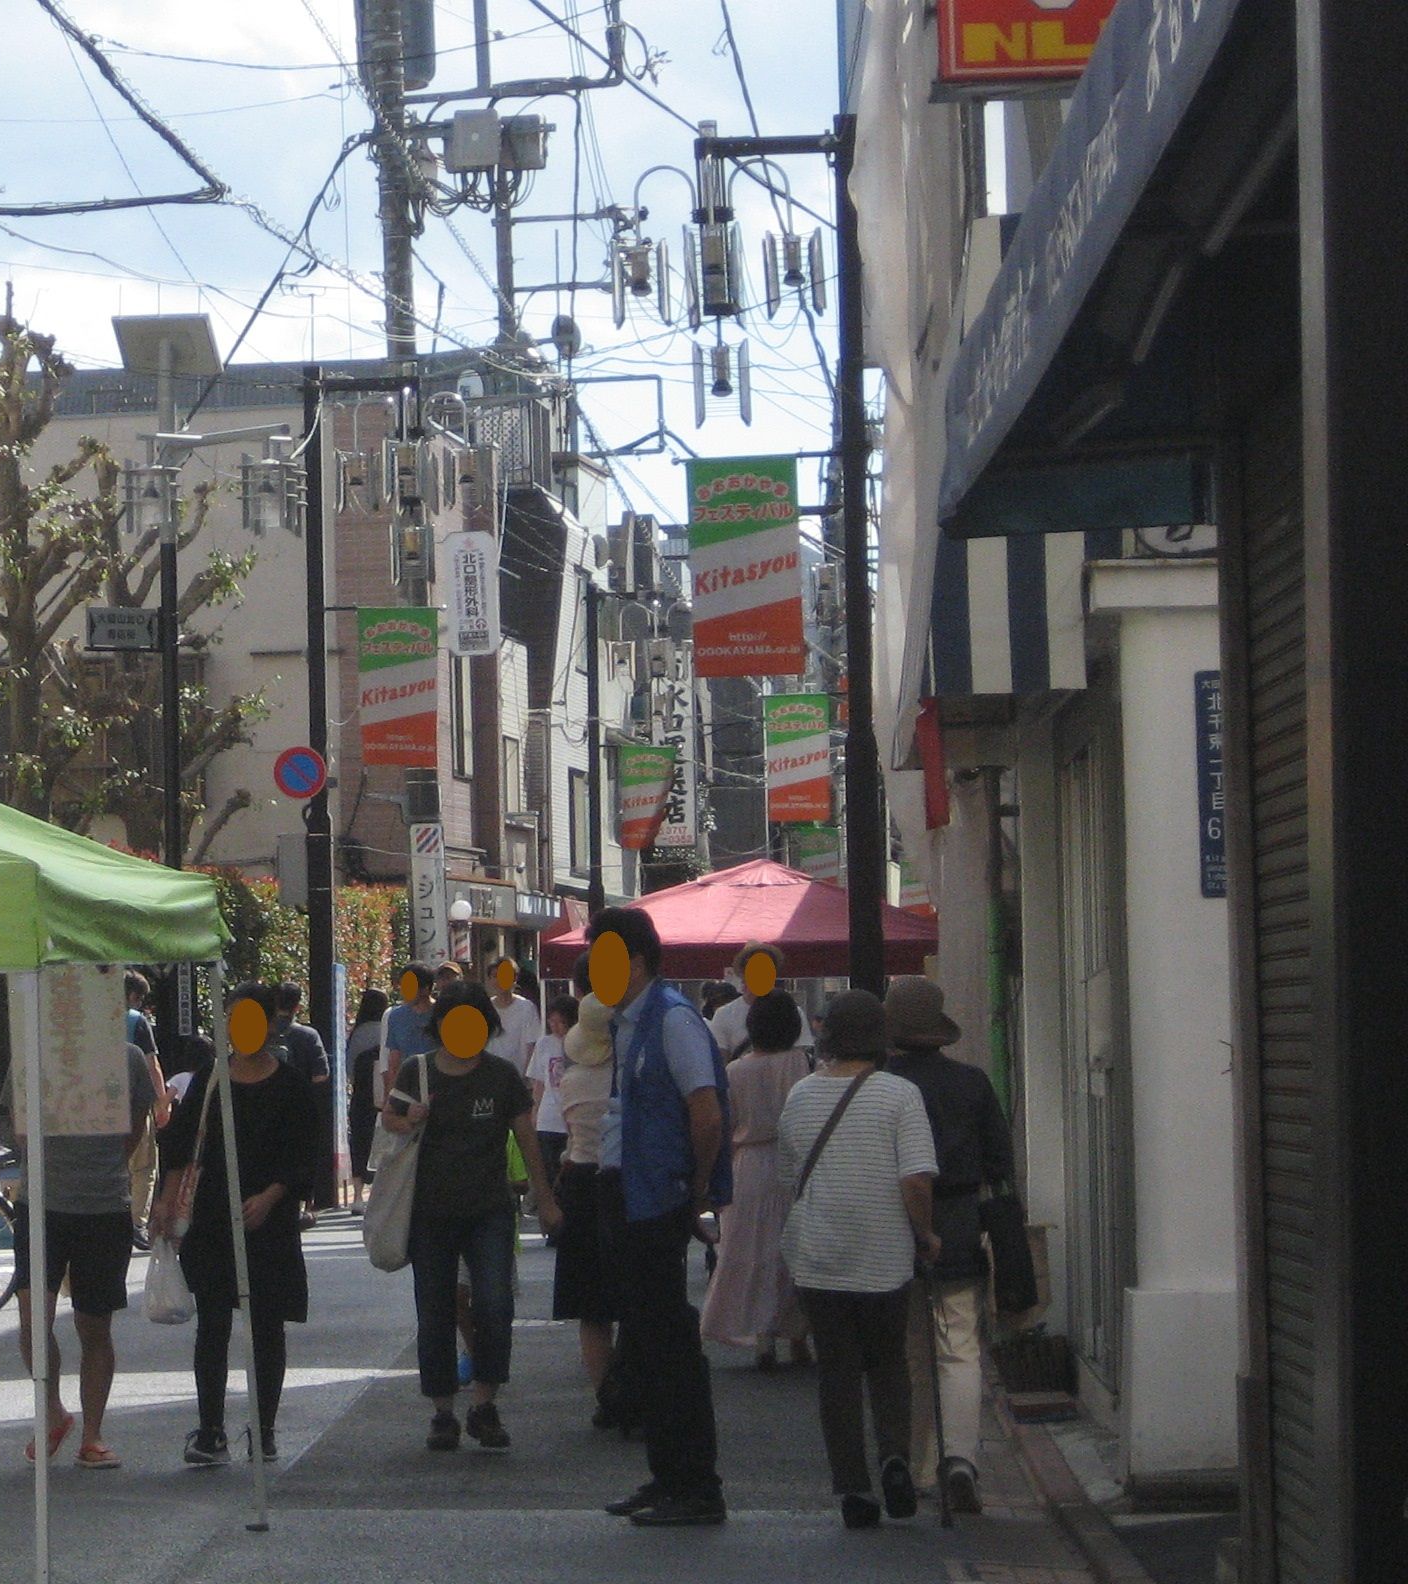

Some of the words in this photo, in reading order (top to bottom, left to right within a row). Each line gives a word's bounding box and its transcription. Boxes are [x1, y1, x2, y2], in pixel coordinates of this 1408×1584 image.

[963, 20, 1110, 62] NL
[692, 502, 794, 522] フェスティバル
[695, 551, 799, 597] Kitasyou
[361, 678, 436, 708] Kitasyou
[768, 749, 829, 775] Kitasyou
[1208, 818, 1222, 840] 6
